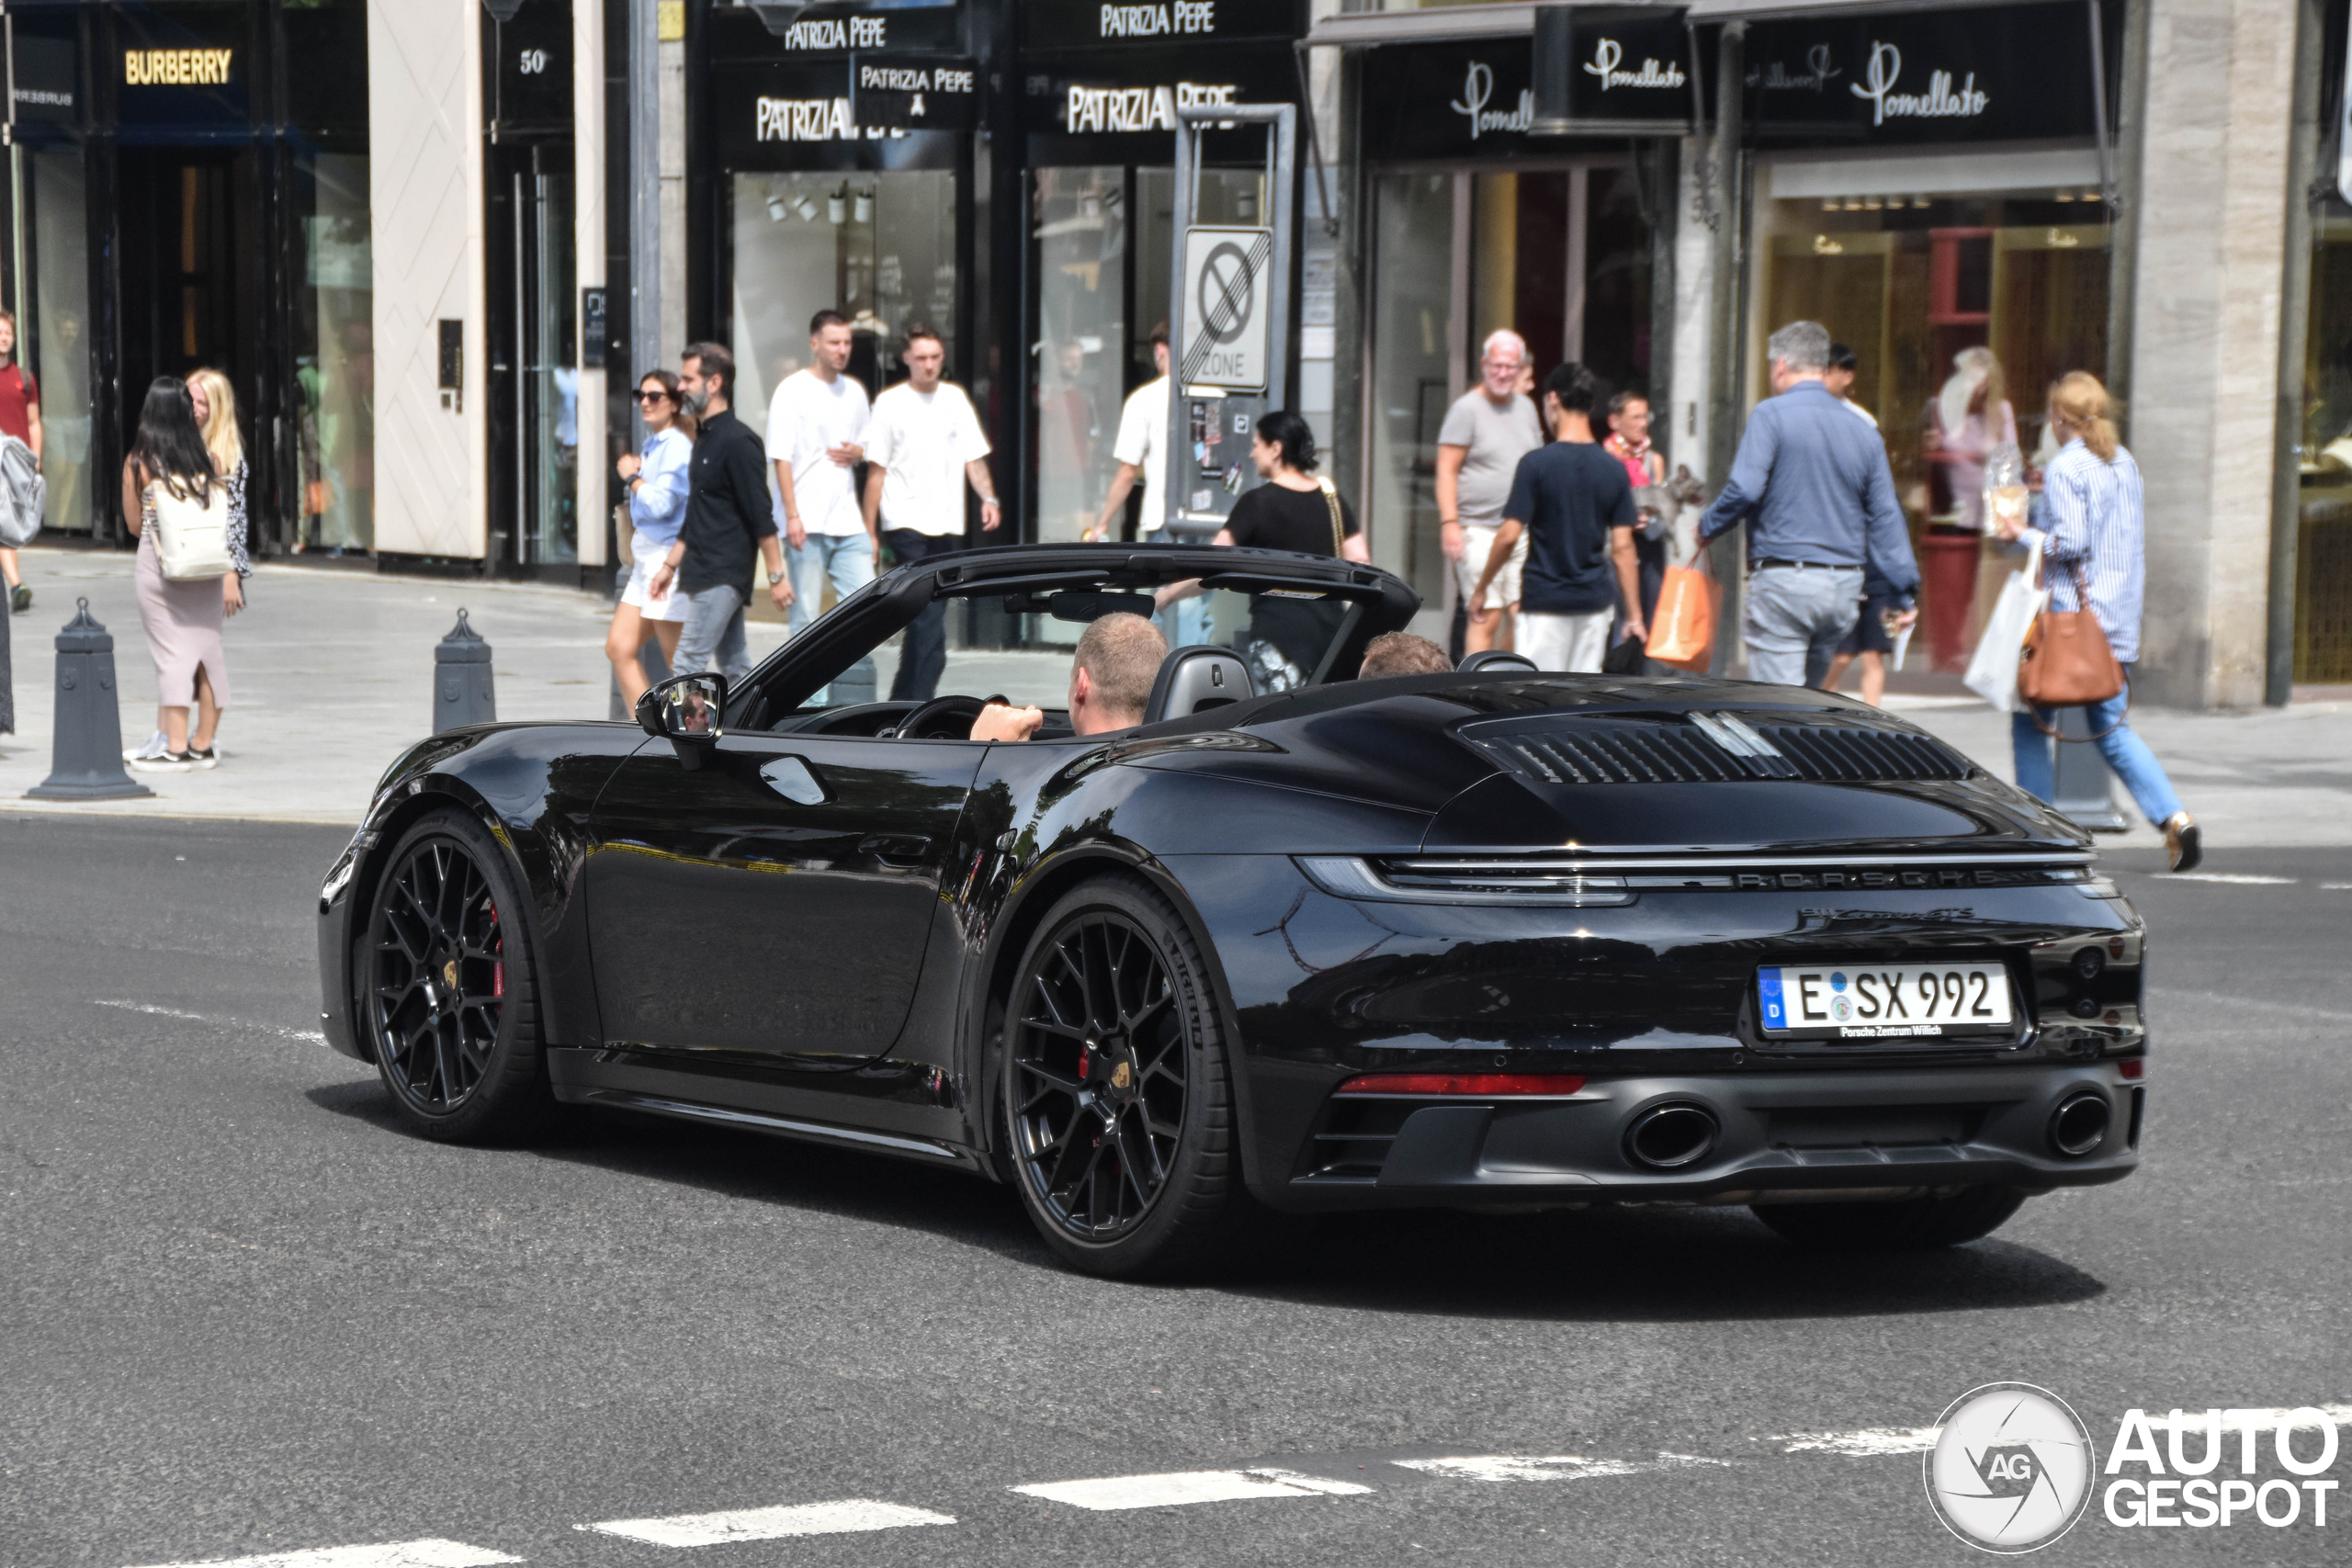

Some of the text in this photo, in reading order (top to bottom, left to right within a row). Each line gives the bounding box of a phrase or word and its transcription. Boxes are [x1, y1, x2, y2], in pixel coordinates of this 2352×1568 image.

[785, 16, 887, 50] PATRIZIA PEPE
[1101, 1, 1215, 37] PATRIZIA PEPE
[125, 49, 232, 85] BURBERRY
[520, 50, 545, 74] 50
[861, 65, 930, 91] PATRIZIA
[934, 68, 974, 93] PEPE
[1583, 38, 1686, 92] Pomellato
[1450, 61, 1534, 140] Pomell
[1849, 39, 1990, 127] Pomellato
[757, 96, 859, 141] PATRIZIA
[1068, 85, 1177, 134] PATRIZIA
[1202, 353, 1245, 378] ZONE
[1737, 870, 1997, 888] PORSCHE
[1170, 950, 1204, 1046] MICHELIN
[1769, 1004, 1781, 1018] D
[1799, 971, 1994, 1021] E SX 992
[1840, 1024, 1942, 1037] Porsche Zentrum Willich
